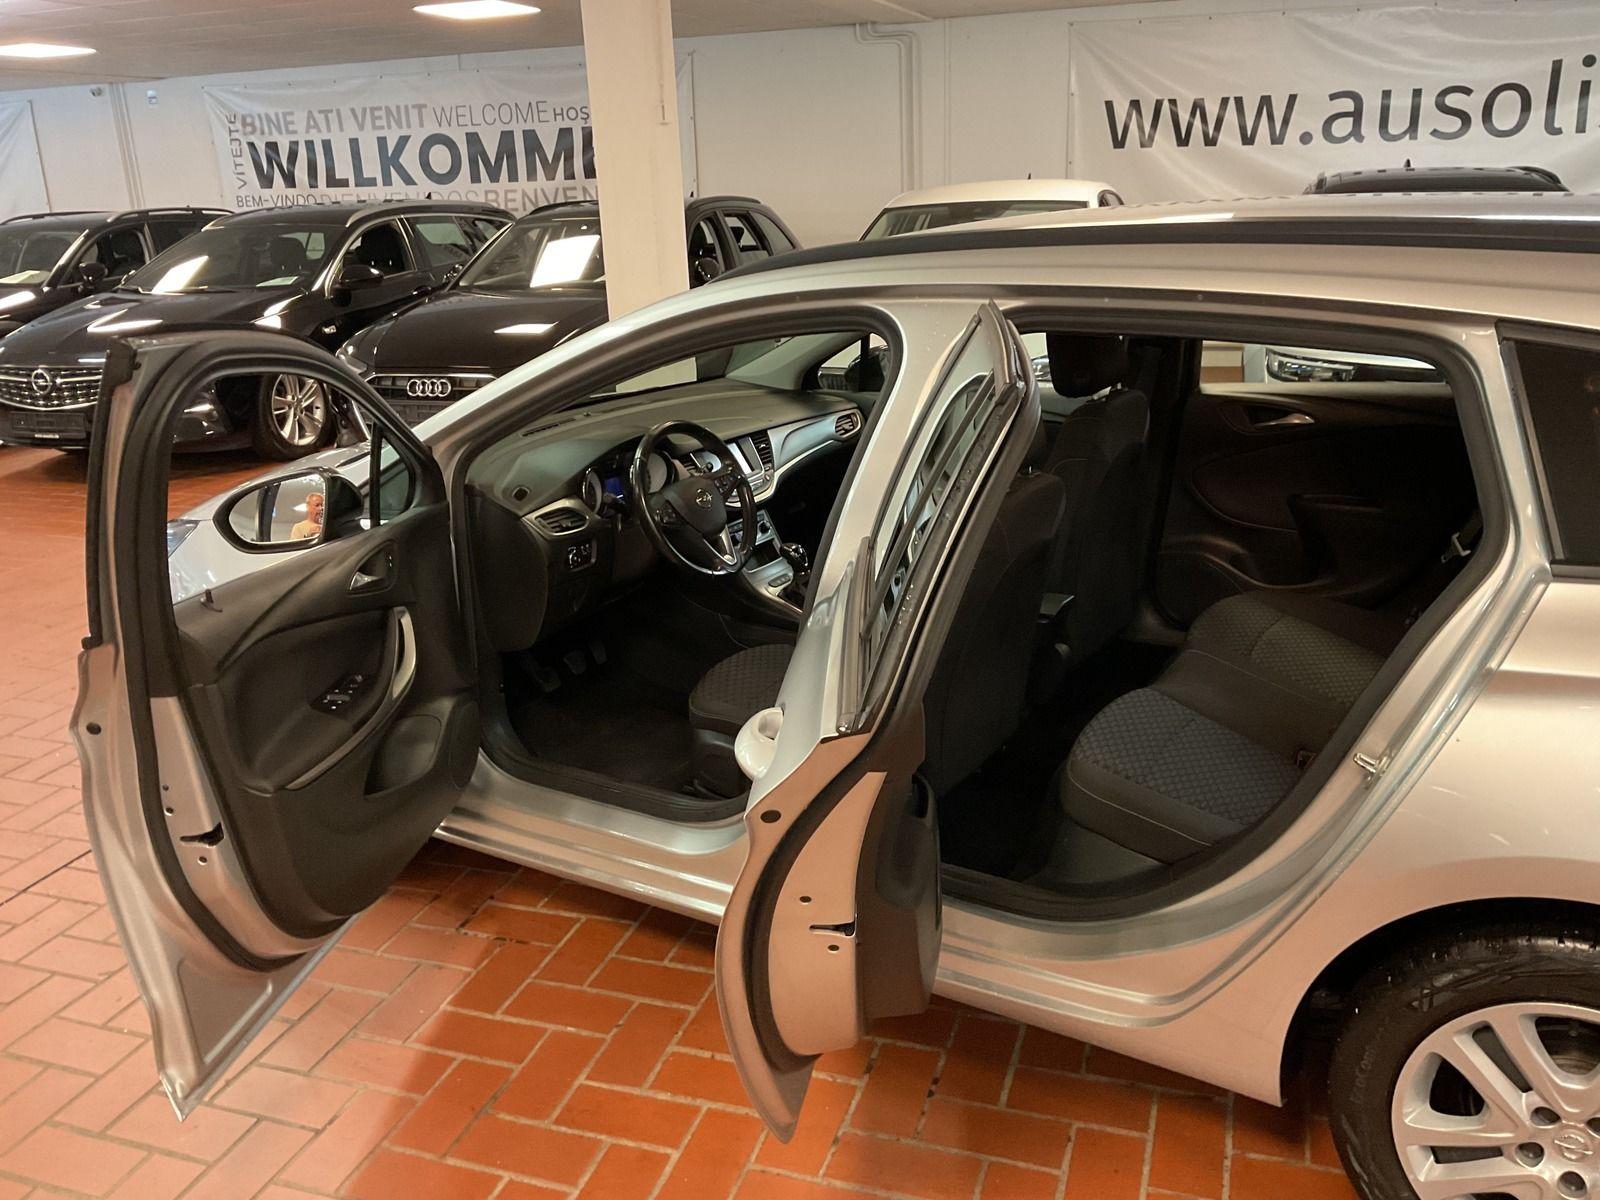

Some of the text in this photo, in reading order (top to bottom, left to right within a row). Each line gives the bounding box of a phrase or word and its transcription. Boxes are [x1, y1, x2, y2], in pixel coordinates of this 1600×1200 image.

[241, 101, 590, 136] BINE ATI VENIT WELCOME HOŞ
[1104, 54, 1600, 149] www.ausoli
[236, 193, 317, 208] BEM-VINDO
